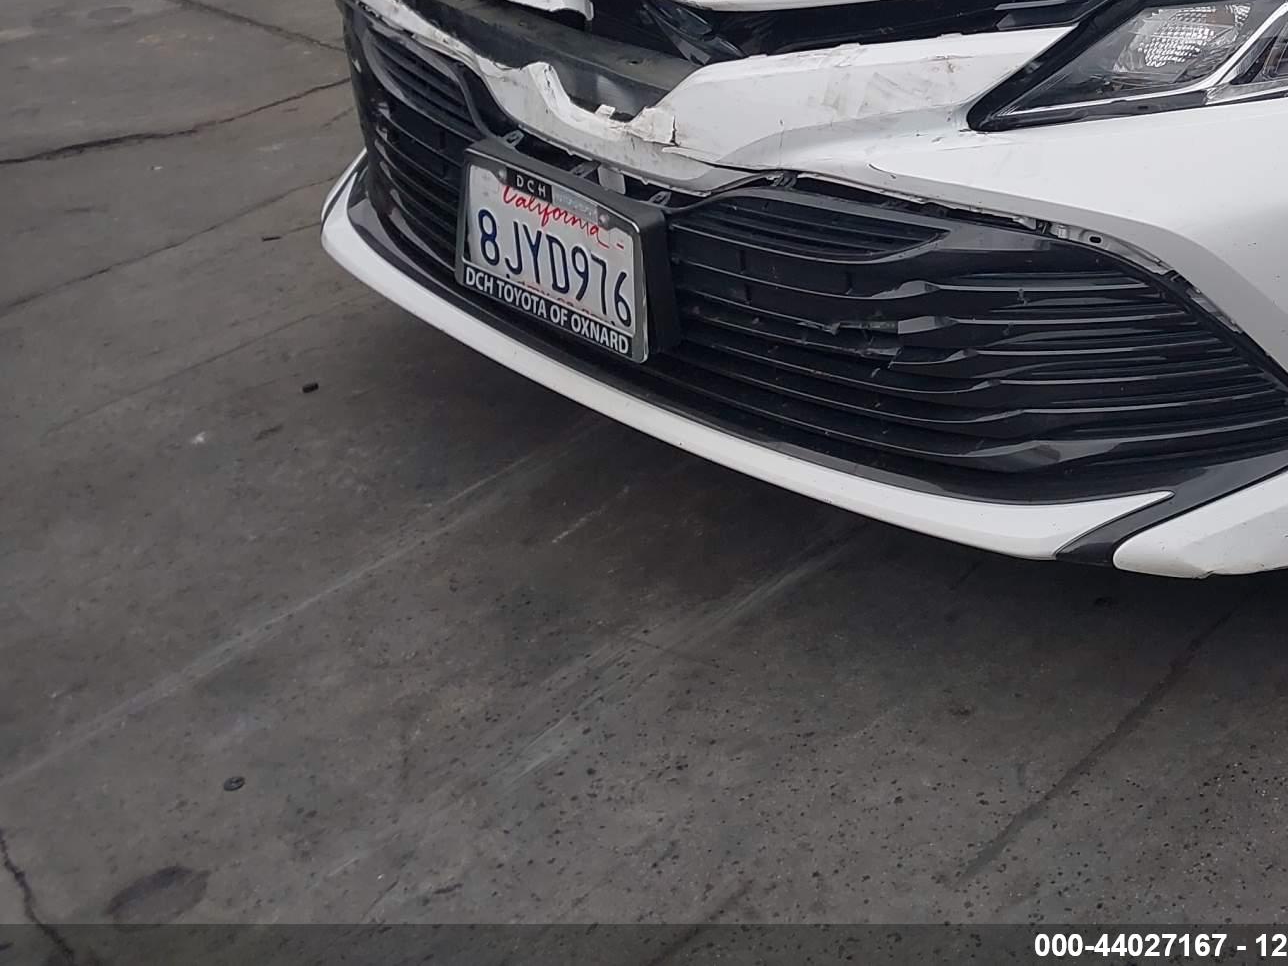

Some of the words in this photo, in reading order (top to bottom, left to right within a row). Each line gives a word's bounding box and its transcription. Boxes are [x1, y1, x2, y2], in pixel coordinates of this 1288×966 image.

[501, 185, 610, 249] California
[515, 174, 547, 198] DCH
[477, 208, 633, 329] 8JYD976
[465, 268, 495, 295] DCH
[496, 280, 548, 319] TOYOTA
[549, 303, 569, 327] OF
[570, 312, 630, 354] OXNARD
